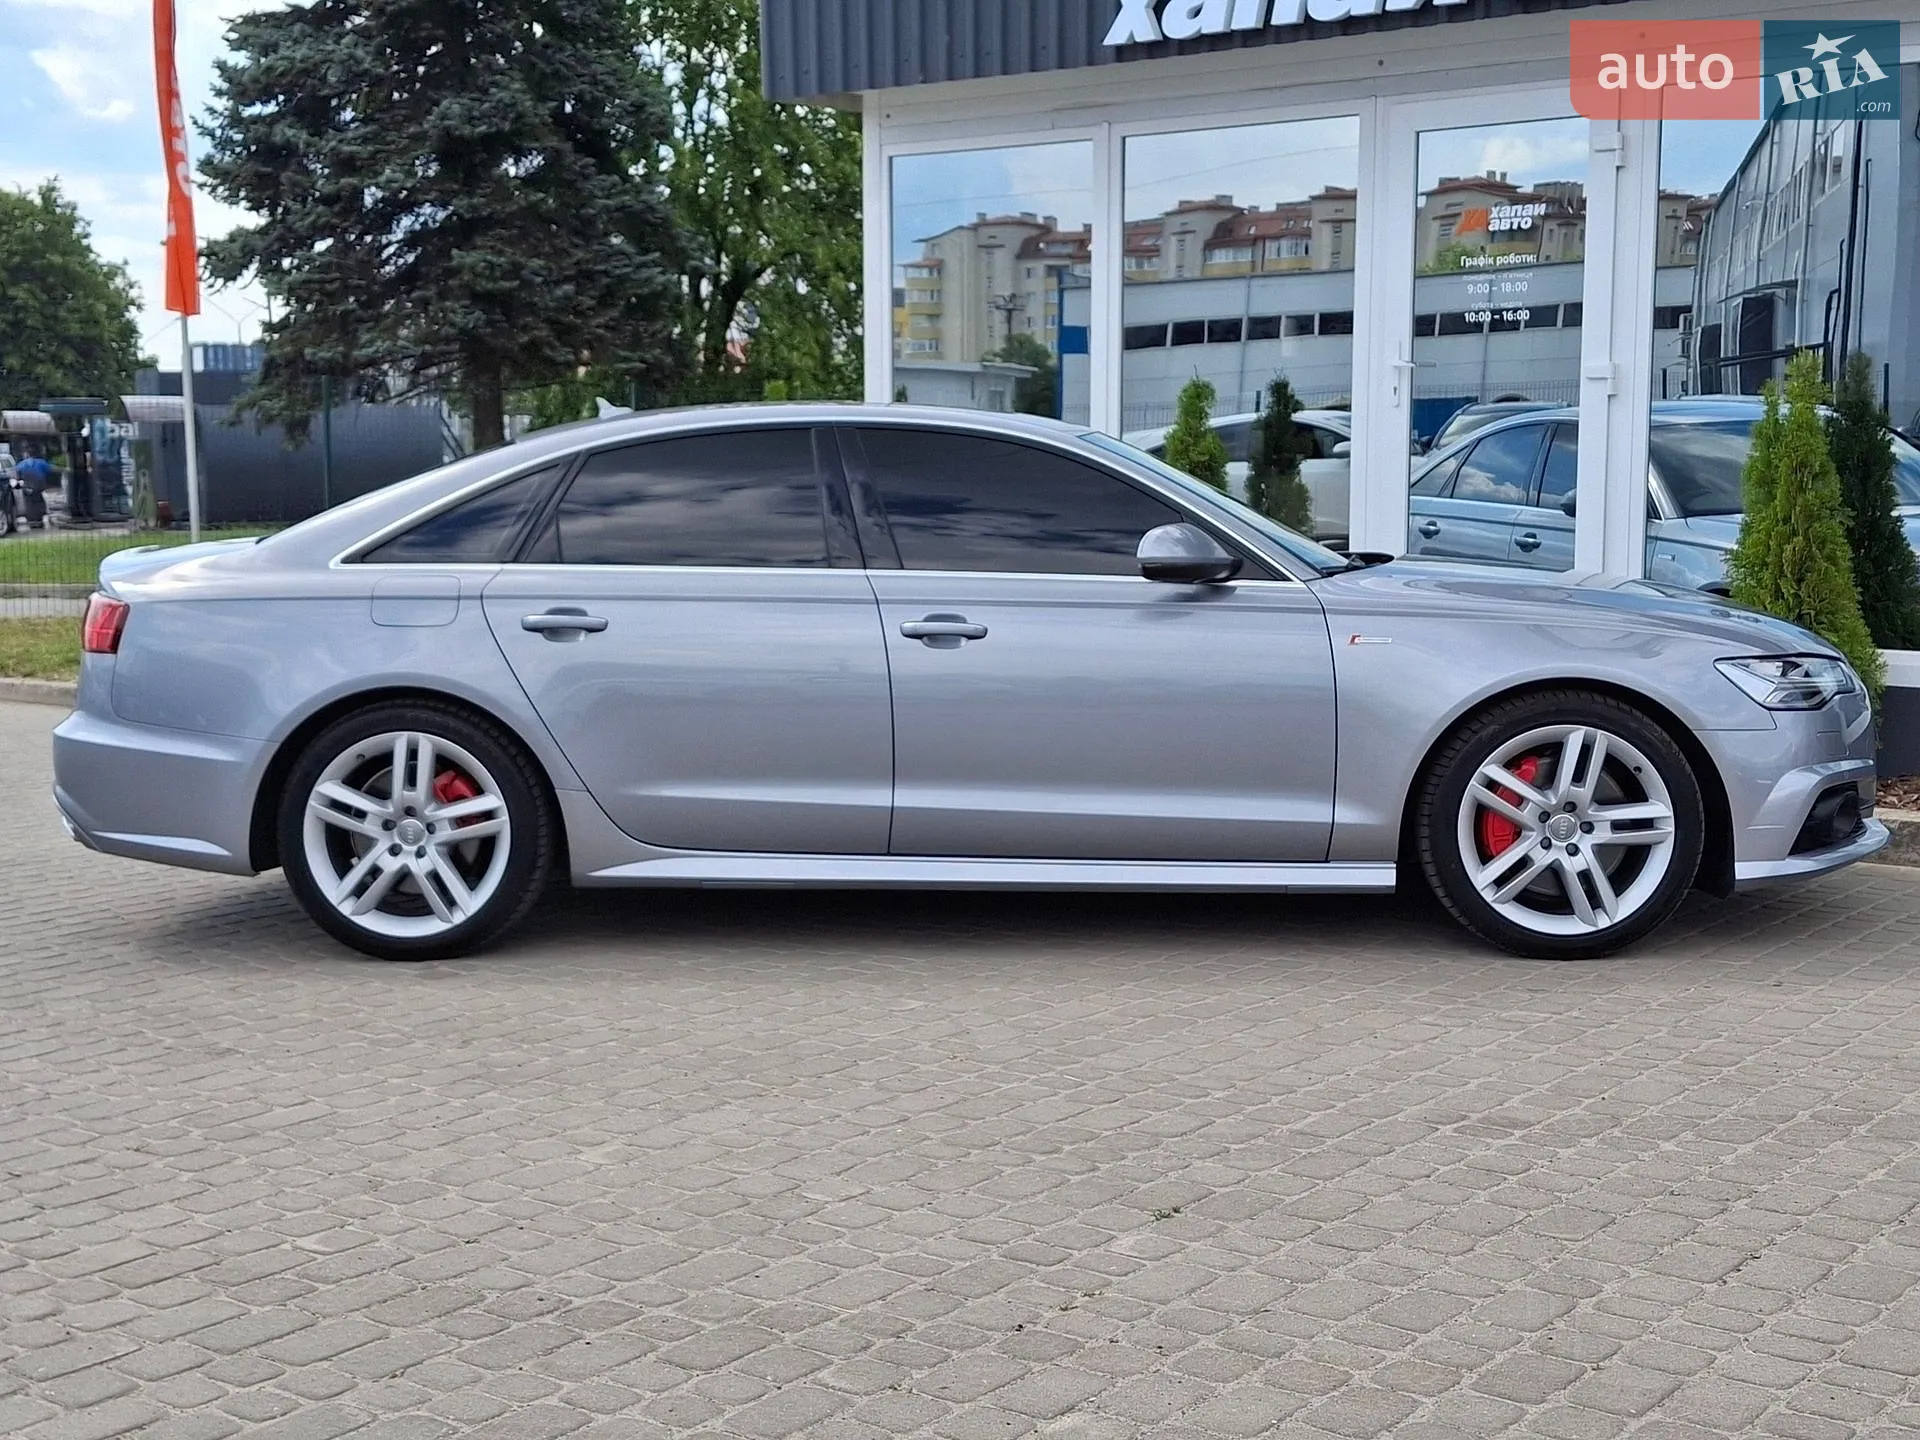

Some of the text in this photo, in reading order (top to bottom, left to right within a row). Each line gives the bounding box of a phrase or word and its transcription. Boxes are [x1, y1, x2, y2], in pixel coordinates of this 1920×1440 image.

[1488, 216, 1532, 231] авто
[1461, 254, 1494, 268] Графік
[1467, 283, 1490, 294] 9:00
[1501, 281, 1528, 293] 18:00
[1464, 311, 1491, 323] 10:00
[1502, 309, 1530, 321] 16:00
